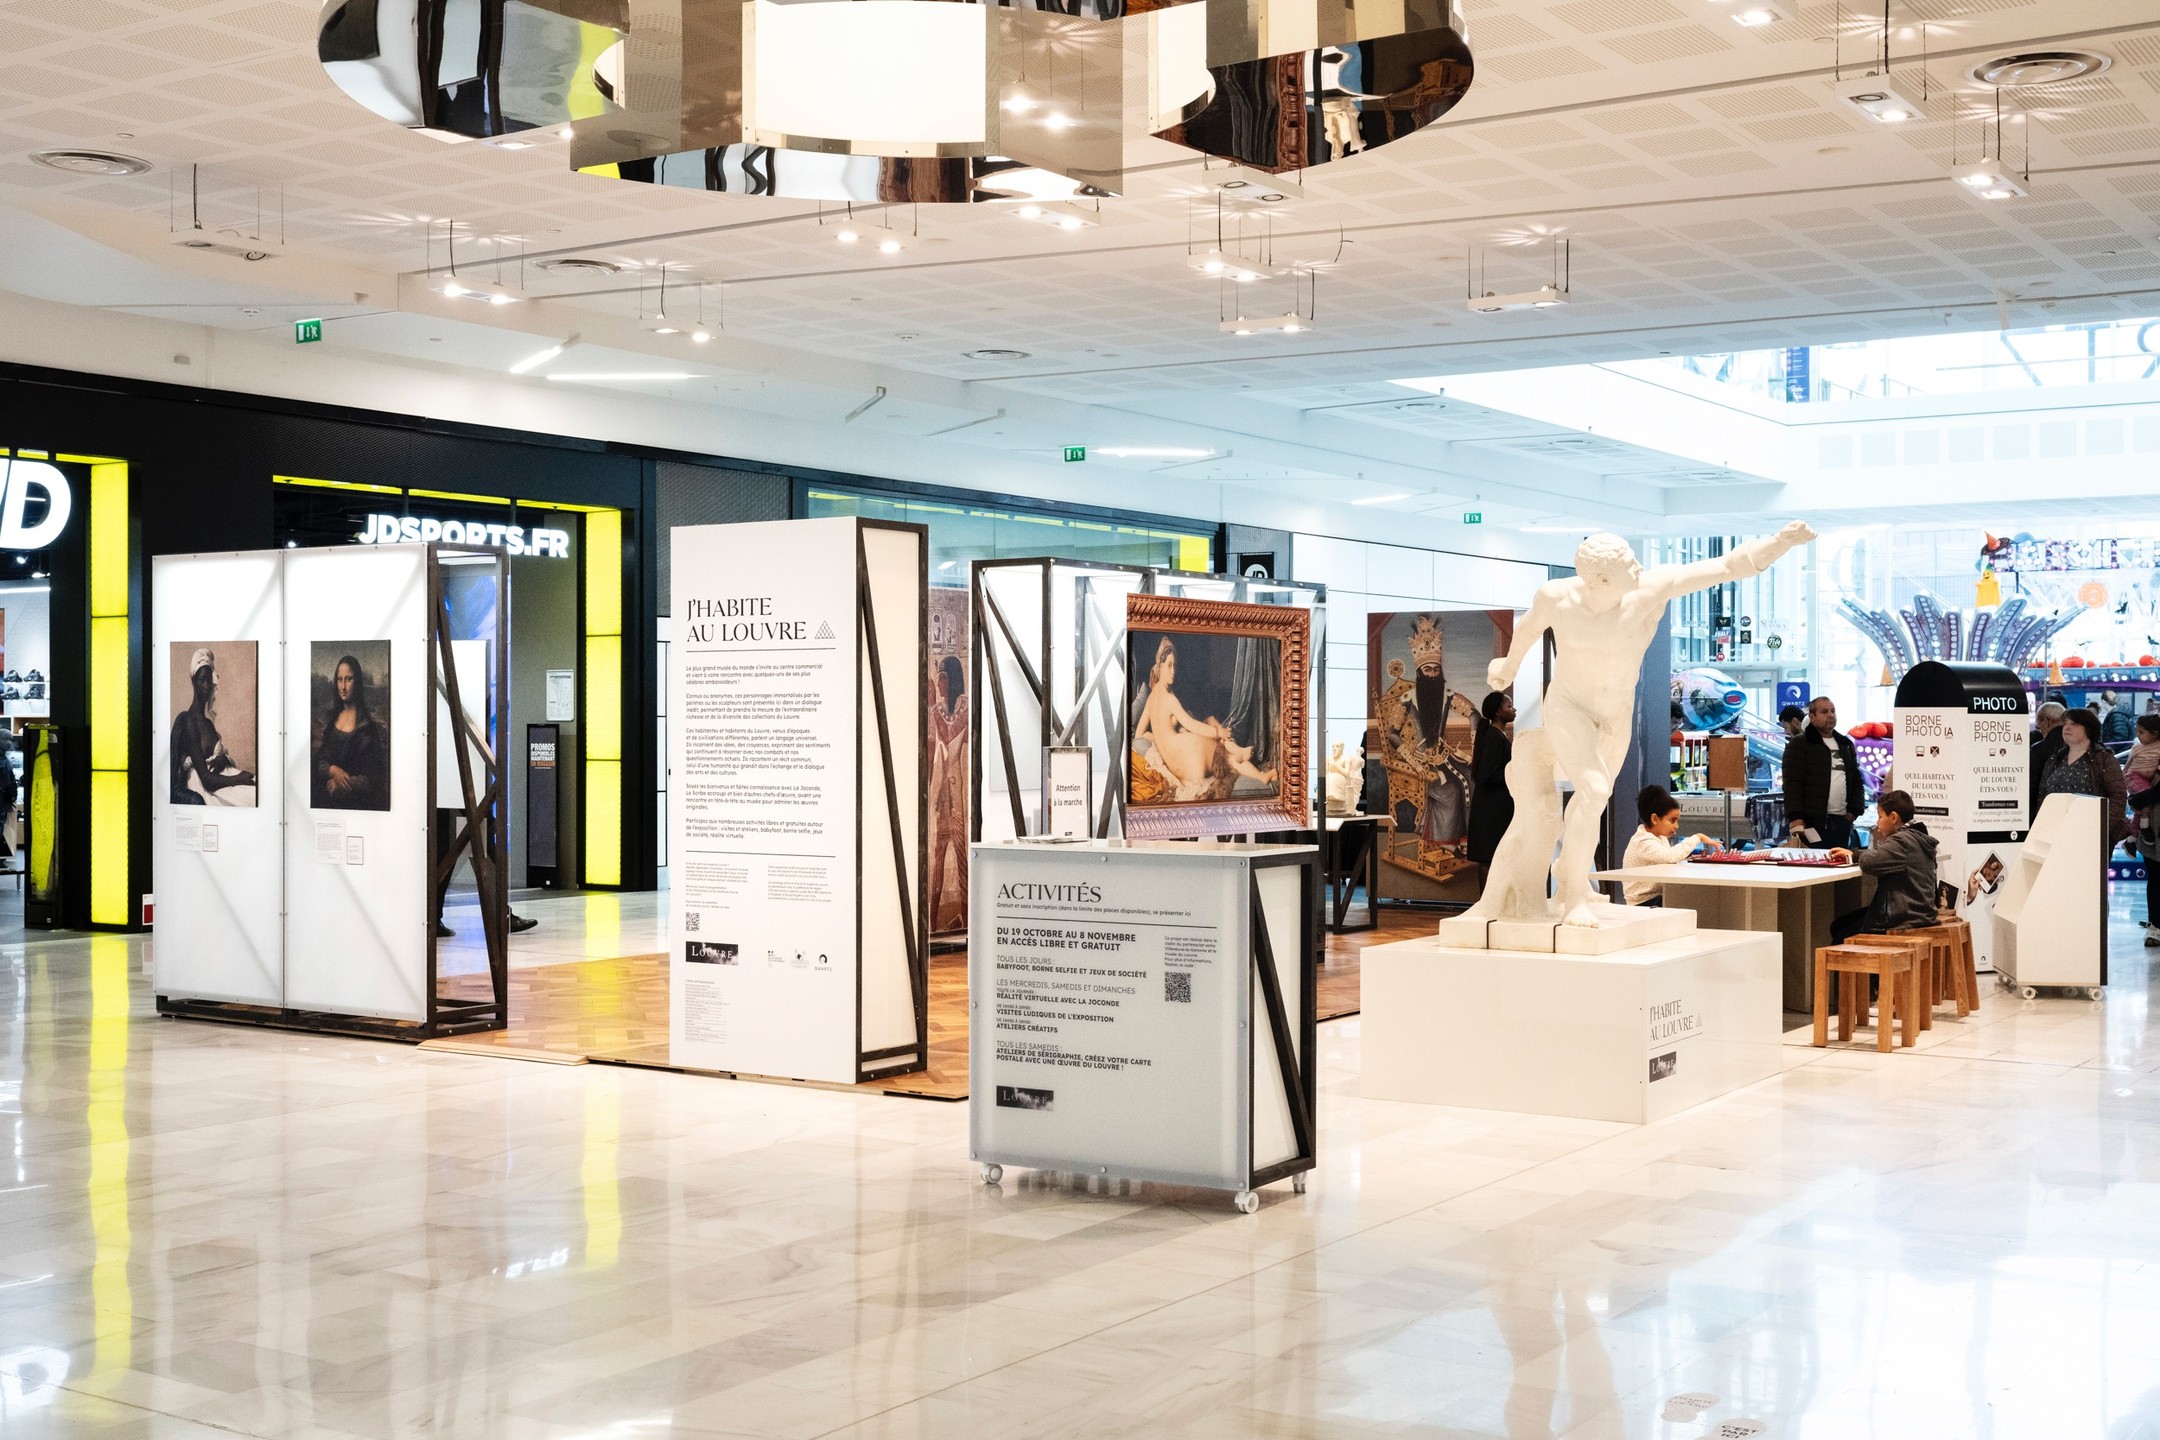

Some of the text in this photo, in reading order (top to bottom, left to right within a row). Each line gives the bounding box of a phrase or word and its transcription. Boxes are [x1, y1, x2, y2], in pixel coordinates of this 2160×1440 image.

[0, 458, 71, 550] D
[358, 513, 569, 558] JDSPORTS.FR
[687, 598, 772, 622] J'HABITE
[686, 622, 807, 642] AU LOUVRE
[1973, 697, 2017, 711] PHOTO
[1905, 715, 1942, 726] BORNE
[1974, 721, 2011, 731] BORNE
[1905, 726, 1954, 736] PHOTO IA
[1974, 732, 2023, 742] PHOTO IA
[530, 743, 555, 751] PROMOS
[998, 882, 1102, 903] ACTIVITÉS
[997, 927, 1009, 935] DU
[1012, 928, 1021, 936] 19
[1023, 928, 1063, 938] OCTOBRE
[1065, 930, 1077, 939] AU
[1087, 932, 1136, 942] NOVEMBRE
[997, 936, 1120, 951] EN ACCÈS LIBRE ET GRATUIT
[997, 955, 1052, 965] TOUS LES JOURS
[997, 963, 1030, 972] BABYFOOT,
[1118, 968, 1147, 978] SOCIÉTÉ
[997, 979, 1136, 994] LES MERCREDIS, SAMEDIS ET DIMANCHES
[997, 992, 1023, 1000] RÉALITÉ
[1024, 994, 1059, 1003] VIRTUELLE
[1088, 998, 1120, 1007] JOCONDE
[1023, 1010, 1056, 1019] LUDIQUES
[997, 1023, 1058, 1033] ATELIERS CRÉATIFS
[1650, 1015, 1693, 1042] AU LOUVRE
[997, 1040, 1059, 1052] TOUS LES SAMEDIS
[997, 1048, 1026, 1057] ATELIERS
[1037, 1050, 1083, 1062] SÉRIGRAPHIE,
[1084, 1054, 1105, 1063] CRÉEZ
[1107, 1057, 1128, 1065] VOTRE
[1130, 1058, 1151, 1066] CARTE
[997, 1055, 1024, 1063] POSTALE
[1093, 1062, 1120, 1070] LOUVRE
